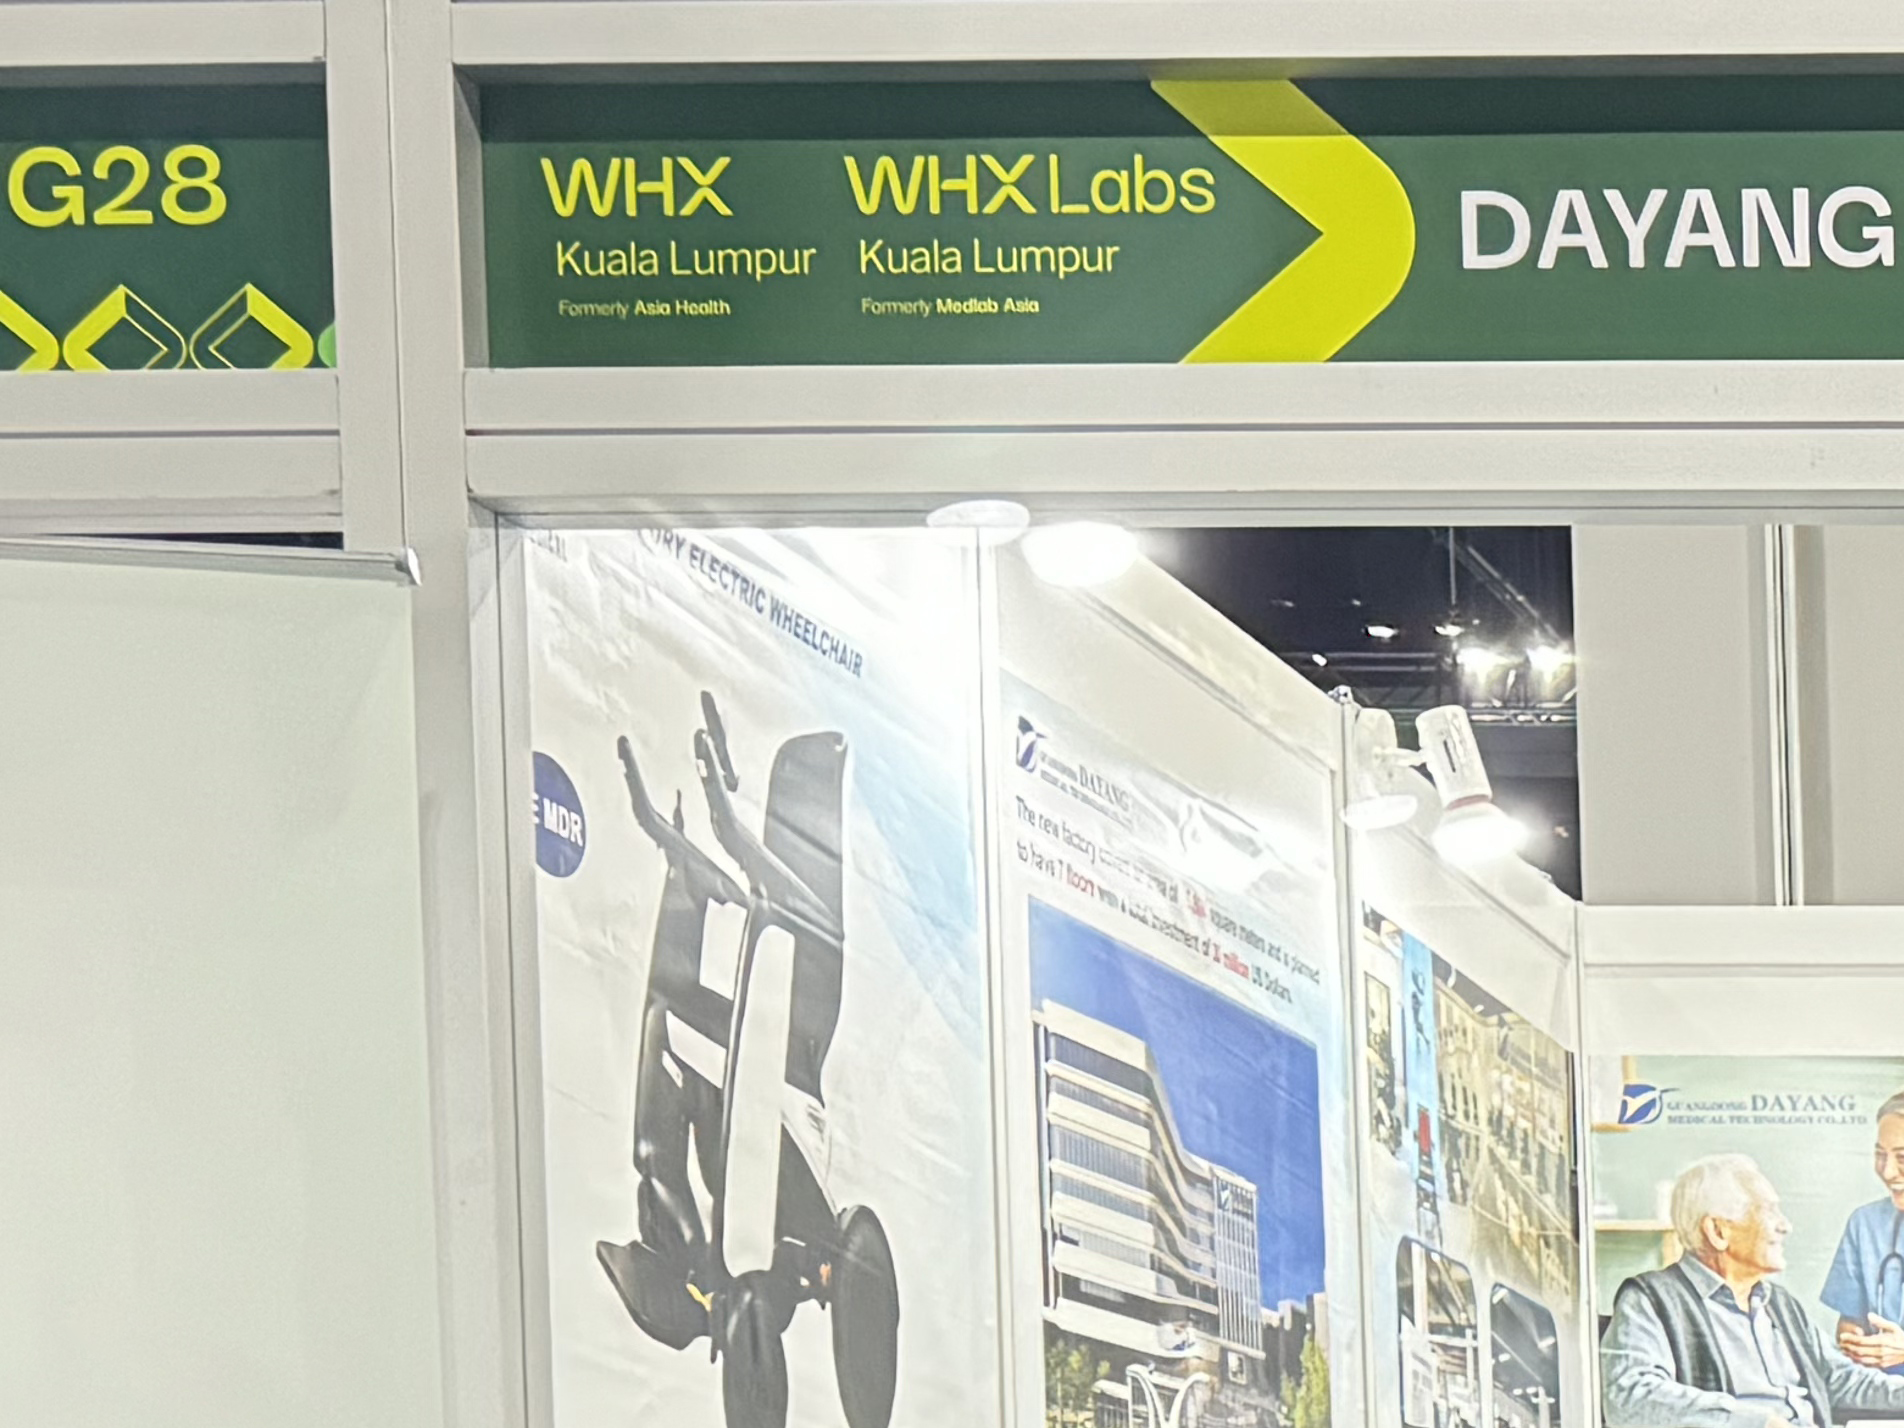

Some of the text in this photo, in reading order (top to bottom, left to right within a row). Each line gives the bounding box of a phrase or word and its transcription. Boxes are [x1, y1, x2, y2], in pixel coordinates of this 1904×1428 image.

[8, 144, 227, 227] G28
[540, 157, 734, 217] WHX
[844, 153, 1216, 215] WHX Labs
[1459, 187, 1895, 269] DAYANG
[556, 240, 817, 282] Kuala Lumpur
[860, 238, 1120, 280] Kuala Lumpur
[559, 300, 731, 319] Formerly Asia Health
[862, 298, 1040, 318] Formerly Medlab Asia
[689, 545, 864, 678] ELECTRIC WHEELCHAIR
[1751, 1094, 1857, 1112] DAYANG
